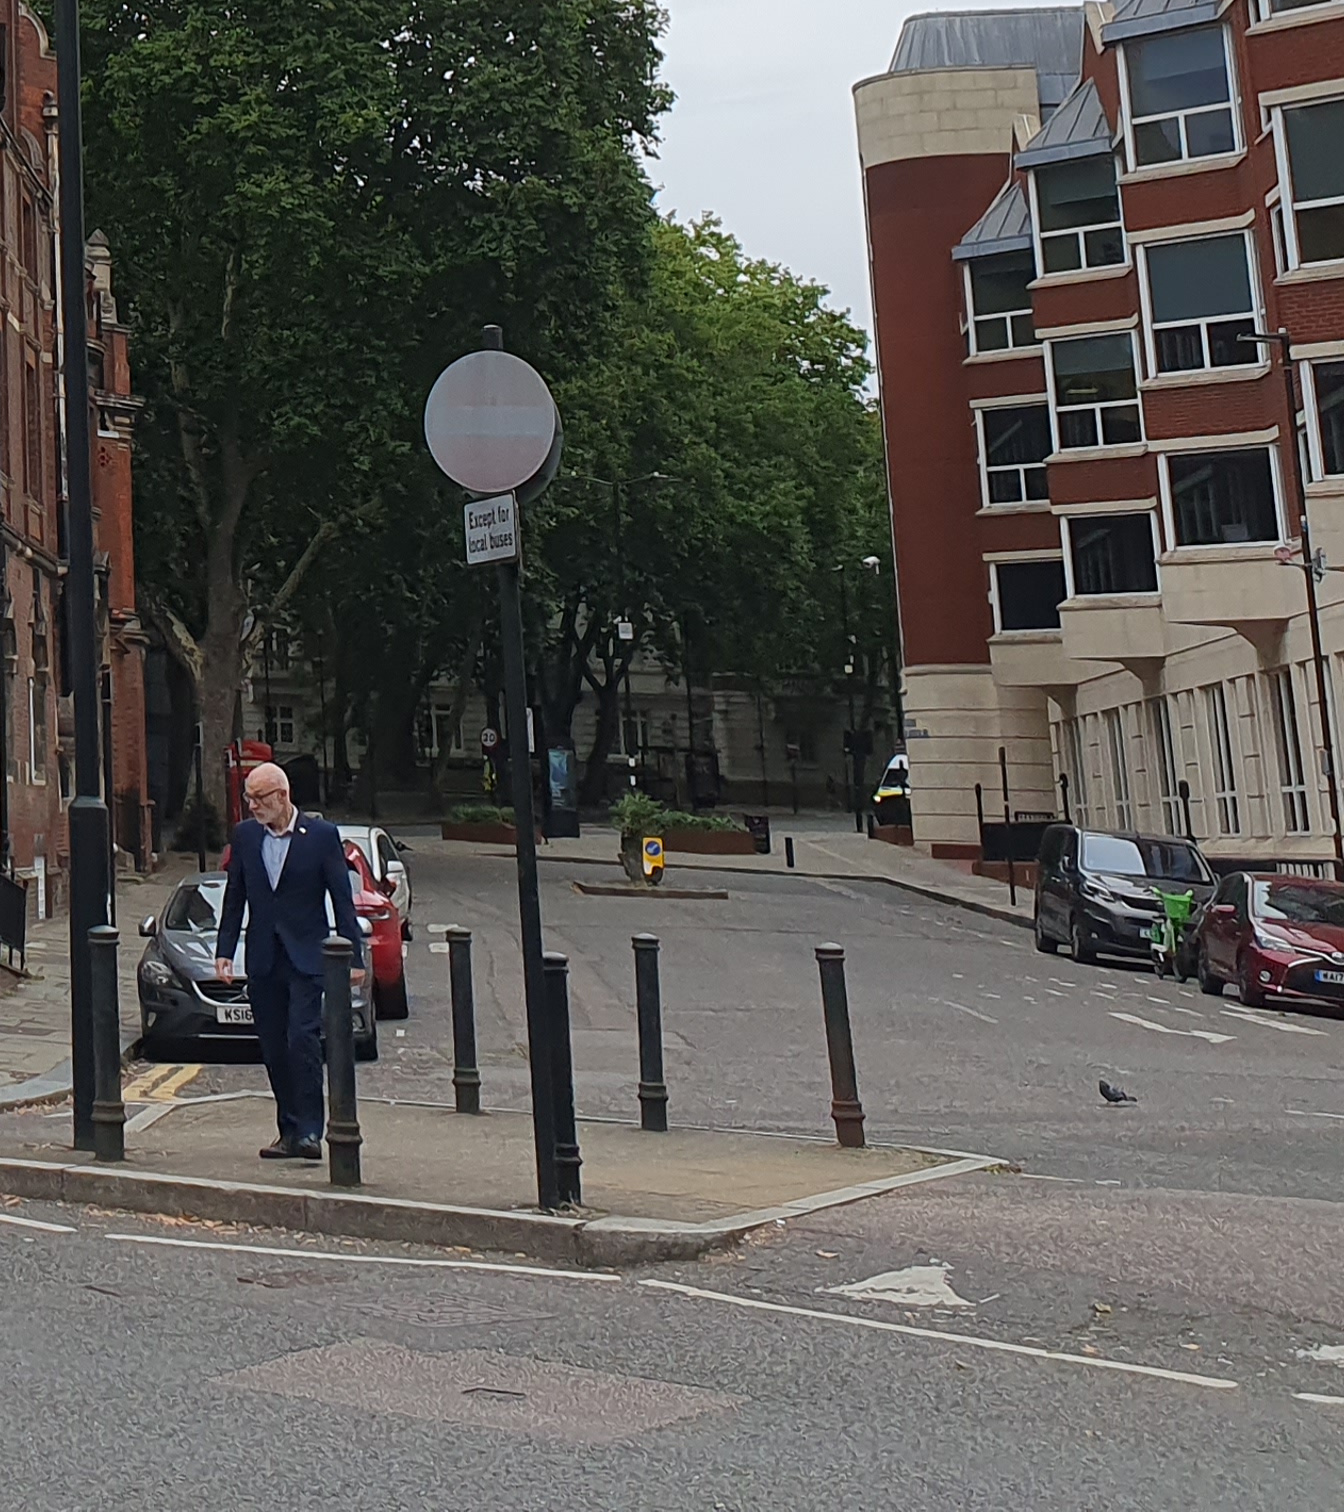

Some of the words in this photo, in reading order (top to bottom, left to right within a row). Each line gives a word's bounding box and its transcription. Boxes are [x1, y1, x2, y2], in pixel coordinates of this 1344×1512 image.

[468, 509, 496, 530] Except
[498, 506, 510, 523] for
[469, 533, 488, 553] local
[489, 532, 513, 549] buses
